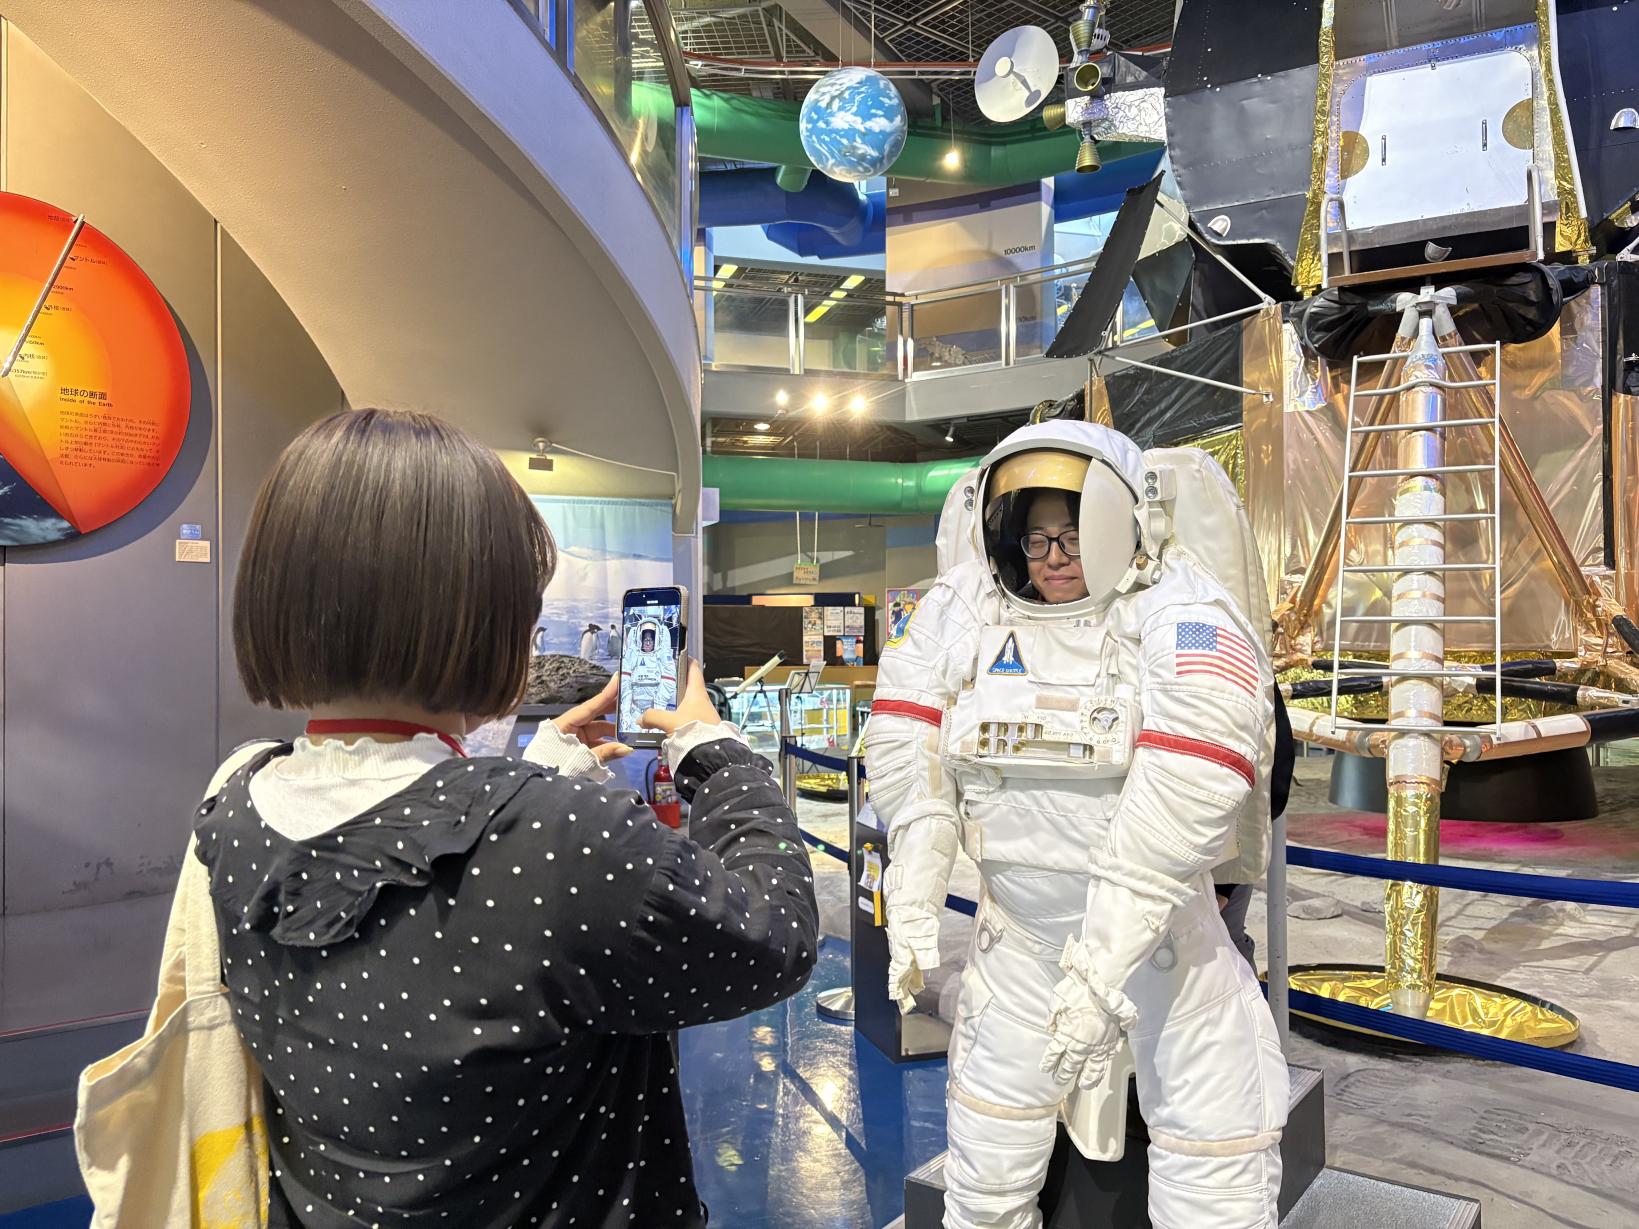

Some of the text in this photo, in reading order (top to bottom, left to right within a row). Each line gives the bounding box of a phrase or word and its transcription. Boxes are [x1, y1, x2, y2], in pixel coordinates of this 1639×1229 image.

[1004, 245, 1036, 256] 10000km
[60, 387, 107, 400] 地球の断面
